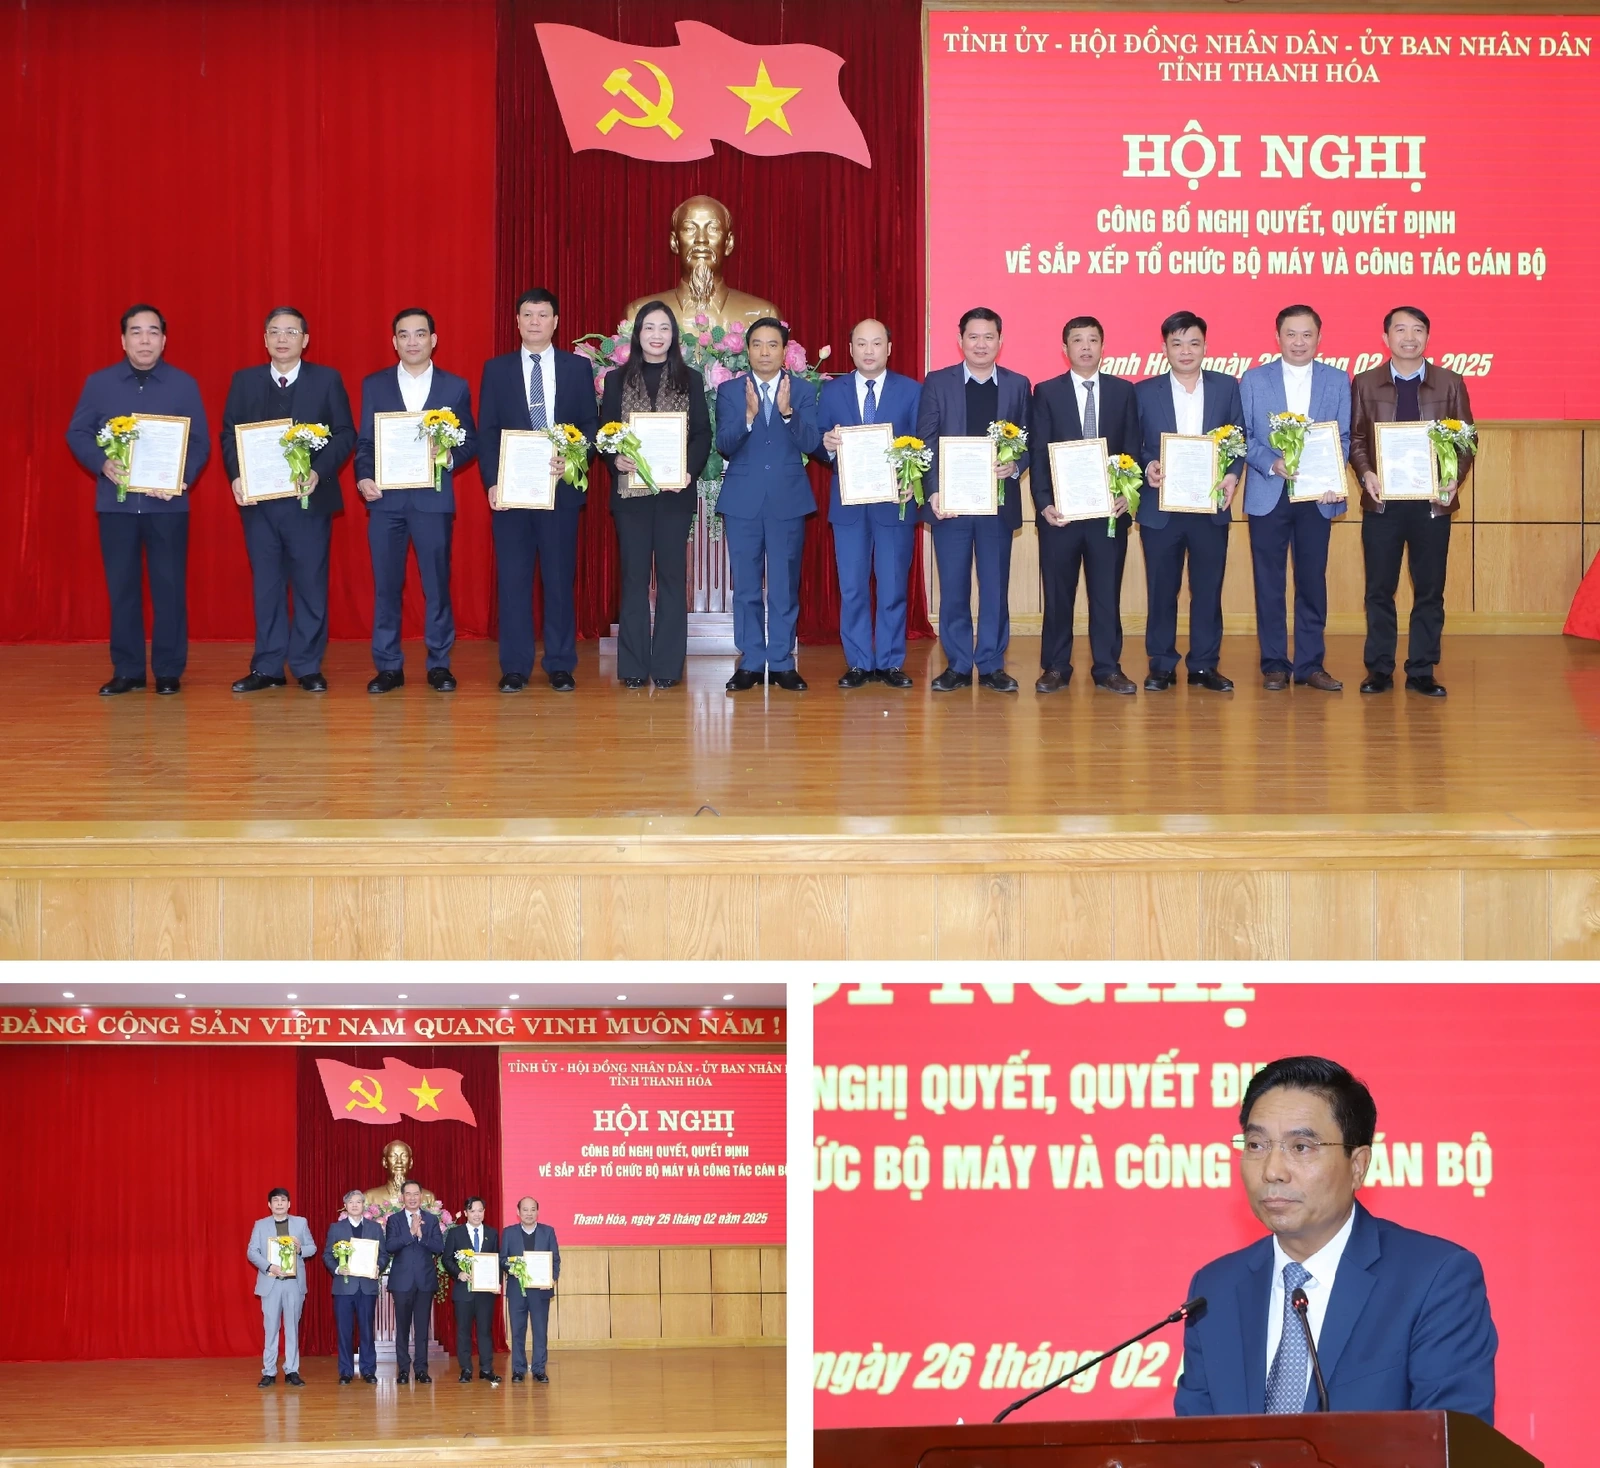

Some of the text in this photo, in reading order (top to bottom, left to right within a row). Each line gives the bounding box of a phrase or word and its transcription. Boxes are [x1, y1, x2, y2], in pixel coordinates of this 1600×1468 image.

[943, 26, 1008, 53] TỈNH
[1014, 26, 1050, 53] ỦY
[1069, 28, 1117, 59] HỘI
[1123, 25, 1199, 55] ĐỒNG
[1205, 29, 1279, 55] NHÂN
[1285, 30, 1339, 55] DÂN
[1359, 28, 1394, 56] ỦY
[1400, 36, 1452, 56] BAN
[1459, 31, 1532, 57] NHÂN
[1539, 32, 1592, 57] DÂN
[1158, 55, 1381, 83] TỈNH THANH HÓA
[1122, 119, 1427, 193] HỘI NGHỊ
[1096, 201, 1456, 239] CÔNG BỐ NGHỊ QUYẾT, QUYẾT ĐỊNH
[1005, 241, 1547, 281] VỀ SẮP XẾP TỔ CHỨC BỘ MÁY VÀ CÔNG TÁC CÁN BỘ
[1098, 353, 1141, 375] anh
[1353, 352, 1383, 375] 02
[1440, 353, 1494, 377] 2025
[1, 1008, 88, 1035] ĐẢNG
[98, 1010, 181, 1040] CỘNG
[189, 1009, 251, 1035] SẢN
[259, 1011, 331, 1040] VIỆT
[338, 1017, 406, 1036] NAM
[414, 1017, 516, 1039] QUANG
[521, 1017, 597, 1035] VINH
[606, 1011, 692, 1035] MUÔN
[698, 1011, 765, 1035] NĂM
[508, 1059, 539, 1073] TỈNH
[541, 1059, 558, 1073] ỦY
[567, 1060, 590, 1075] HỘI
[630, 1061, 665, 1073] NHÂN
[667, 1061, 693, 1073] DÂN
[702, 1060, 719, 1074] ỦY
[721, 1063, 745, 1074] BAN
[748, 1061, 782, 1074] NHÂN
[608, 1073, 713, 1087] TỈNH THANH HÓA
[921, 1049, 1058, 1115] QUYẾT,
[1069, 1048, 1200, 1115] QUYẾT
[592, 1103, 735, 1138] HỘI NGHỊ
[581, 1142, 749, 1160] CÔNG BỐ NGHỊ QUYẾT, QUYẾT ĐỊNH
[873, 1135, 931, 1201] BỘ
[942, 1134, 1037, 1190] MÁY
[1047, 1133, 1104, 1190] VÀ
[1114, 1133, 1232, 1190] CÔNG
[1363, 1131, 1424, 1188] ÁN
[1436, 1131, 1493, 1198] BỘ
[577, 1162, 598, 1177] XẾP
[615, 1163, 643, 1177] CHỨC
[645, 1162, 660, 1180] BỘ
[661, 1162, 684, 1177] MÁY
[686, 1162, 700, 1177] VÀ
[702, 1162, 731, 1177] CÔNG
[732, 1163, 753, 1177] TÁC
[754, 1163, 776, 1177] CÁN
[777, 1163, 787, 1177] B
[573, 1212, 769, 1227] Thanh Hóa, ngày 26 tháng 02 năm 2025
[813, 1341, 912, 1396] ngày
[912, 1342, 976, 1390] 26
[979, 1341, 1106, 1395] tháng
[1109, 1341, 1171, 1389] 02
